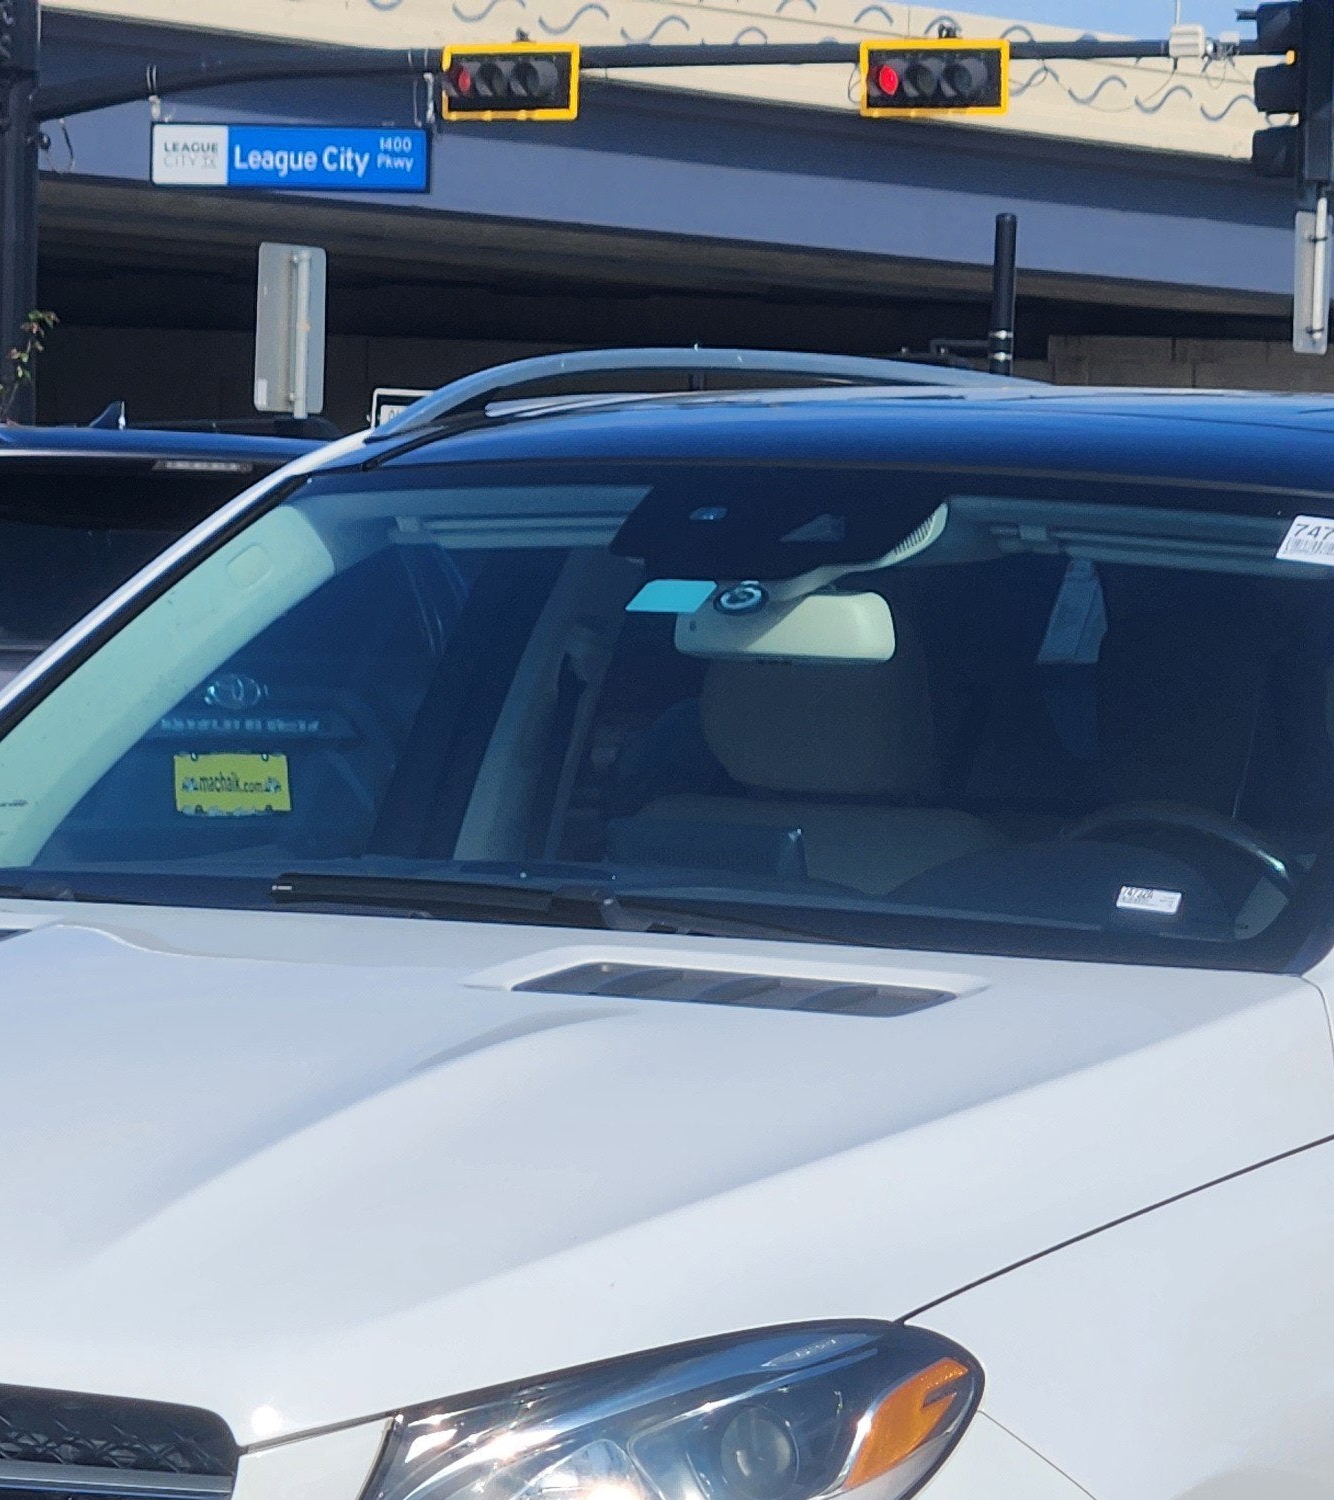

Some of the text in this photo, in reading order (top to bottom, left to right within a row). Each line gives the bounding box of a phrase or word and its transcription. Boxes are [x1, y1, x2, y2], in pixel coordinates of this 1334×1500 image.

[163, 141, 218, 153] LEAGUE
[379, 136, 412, 152] 1400
[163, 154, 197, 168] CITY
[234, 144, 370, 178] League City
[376, 153, 414, 172] Pkwy
